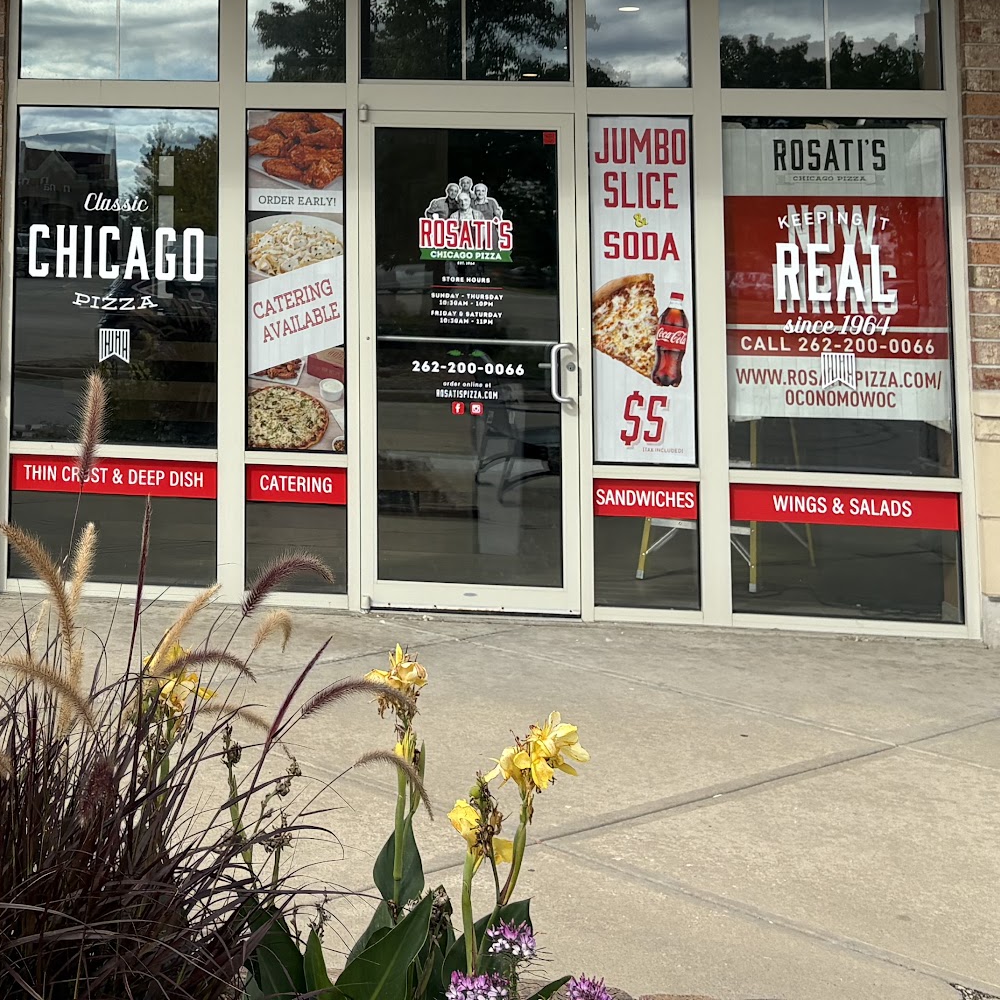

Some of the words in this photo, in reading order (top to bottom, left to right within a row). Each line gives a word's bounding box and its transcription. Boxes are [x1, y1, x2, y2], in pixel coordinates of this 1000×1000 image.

[594, 127, 687, 165] JUMBO
[773, 139, 886, 171] ROSATI'S
[792, 174, 835, 182] CHICAGO
[836, 174, 867, 182] PIZZA
[258, 195, 295, 205] ORDER
[297, 197, 337, 206] EARLY!
[603, 171, 679, 209] SLICE
[83, 192, 149, 212] Classic
[777, 211, 863, 230] KEEPING
[871, 215, 890, 231] IT
[786, 204, 878, 255] NOW
[419, 217, 513, 251] ROSATI'S
[28, 223, 205, 282] CHICAGO
[430, 250, 473, 260] CHICAGO
[475, 252, 502, 260] PIZZA
[603, 231, 680, 261] SODA
[775, 242, 897, 302] REAL
[72, 292, 158, 310] PIZZA
[253, 279, 334, 319] CATERING
[263, 302, 341, 343] AVAILABLE
[783, 316, 836, 335] since
[837, 315, 891, 336] 1964
[740, 336, 791, 351] CALL
[798, 337, 935, 354] 262-200-0066
[411, 360, 525, 376] 262-200-0066
[736, 368, 942, 390] WWW.ROSPIZZA.COM/
[436, 389, 498, 400] ROSATISPIZZA.COM
[785, 389, 896, 408] OCONOMOWOC
[620, 390, 668, 446] $5
[23, 464, 58, 481] THIN
[112, 468, 123, 484] &
[127, 469, 165, 486] DEEP
[168, 471, 204, 487] DISH
[259, 474, 333, 494] CATERING
[596, 489, 695, 509] SANDWICHES
[773, 494, 828, 514] WINGS
[831, 498, 845, 515] &
[849, 500, 912, 518] SALADS
